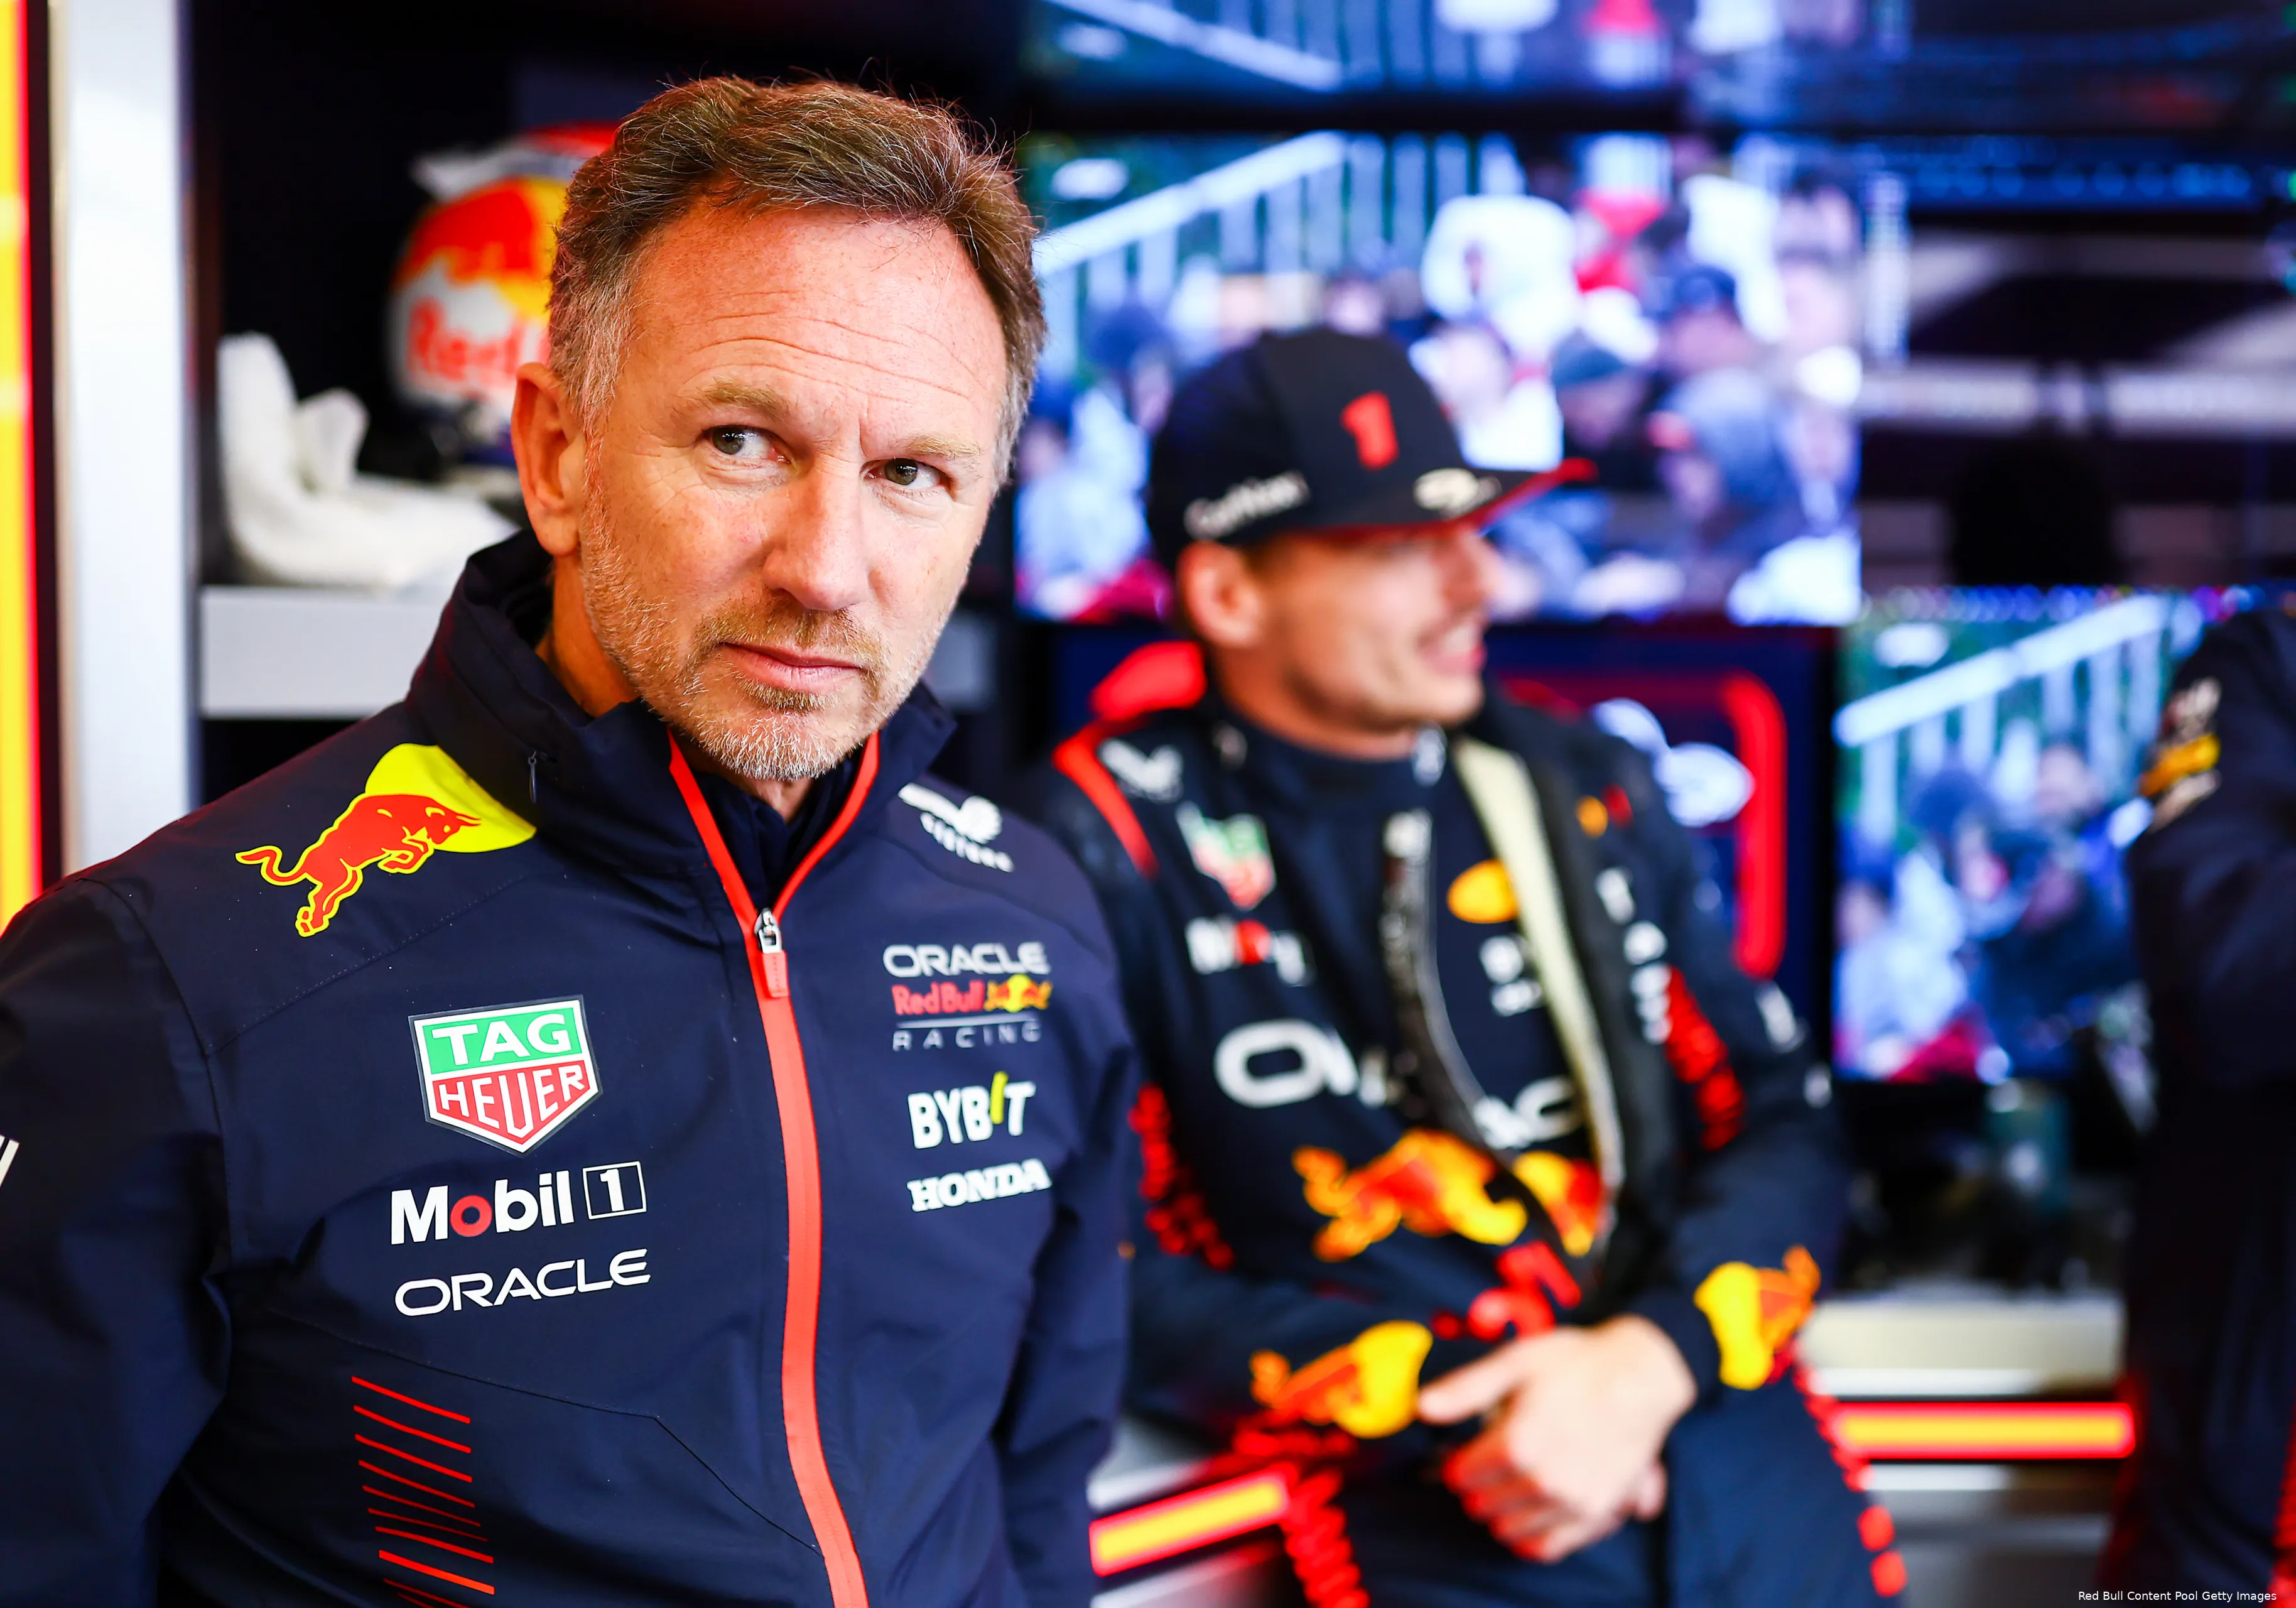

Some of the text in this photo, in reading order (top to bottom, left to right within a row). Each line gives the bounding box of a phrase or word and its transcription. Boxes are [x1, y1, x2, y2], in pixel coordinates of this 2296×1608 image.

[1341, 391, 1399, 471] 1
[882, 941, 1051, 977] ORACLE
[431, 1013, 572, 1066] TAG
[892, 1021, 1042, 1051] RACING
[438, 1064, 585, 1139] HEUER
[907, 1070, 1036, 1149] BYBIT
[391, 1168, 625, 1245] Mobil 1
[907, 1158, 1052, 1212] HONDA
[394, 1248, 651, 1317] ORACLE
